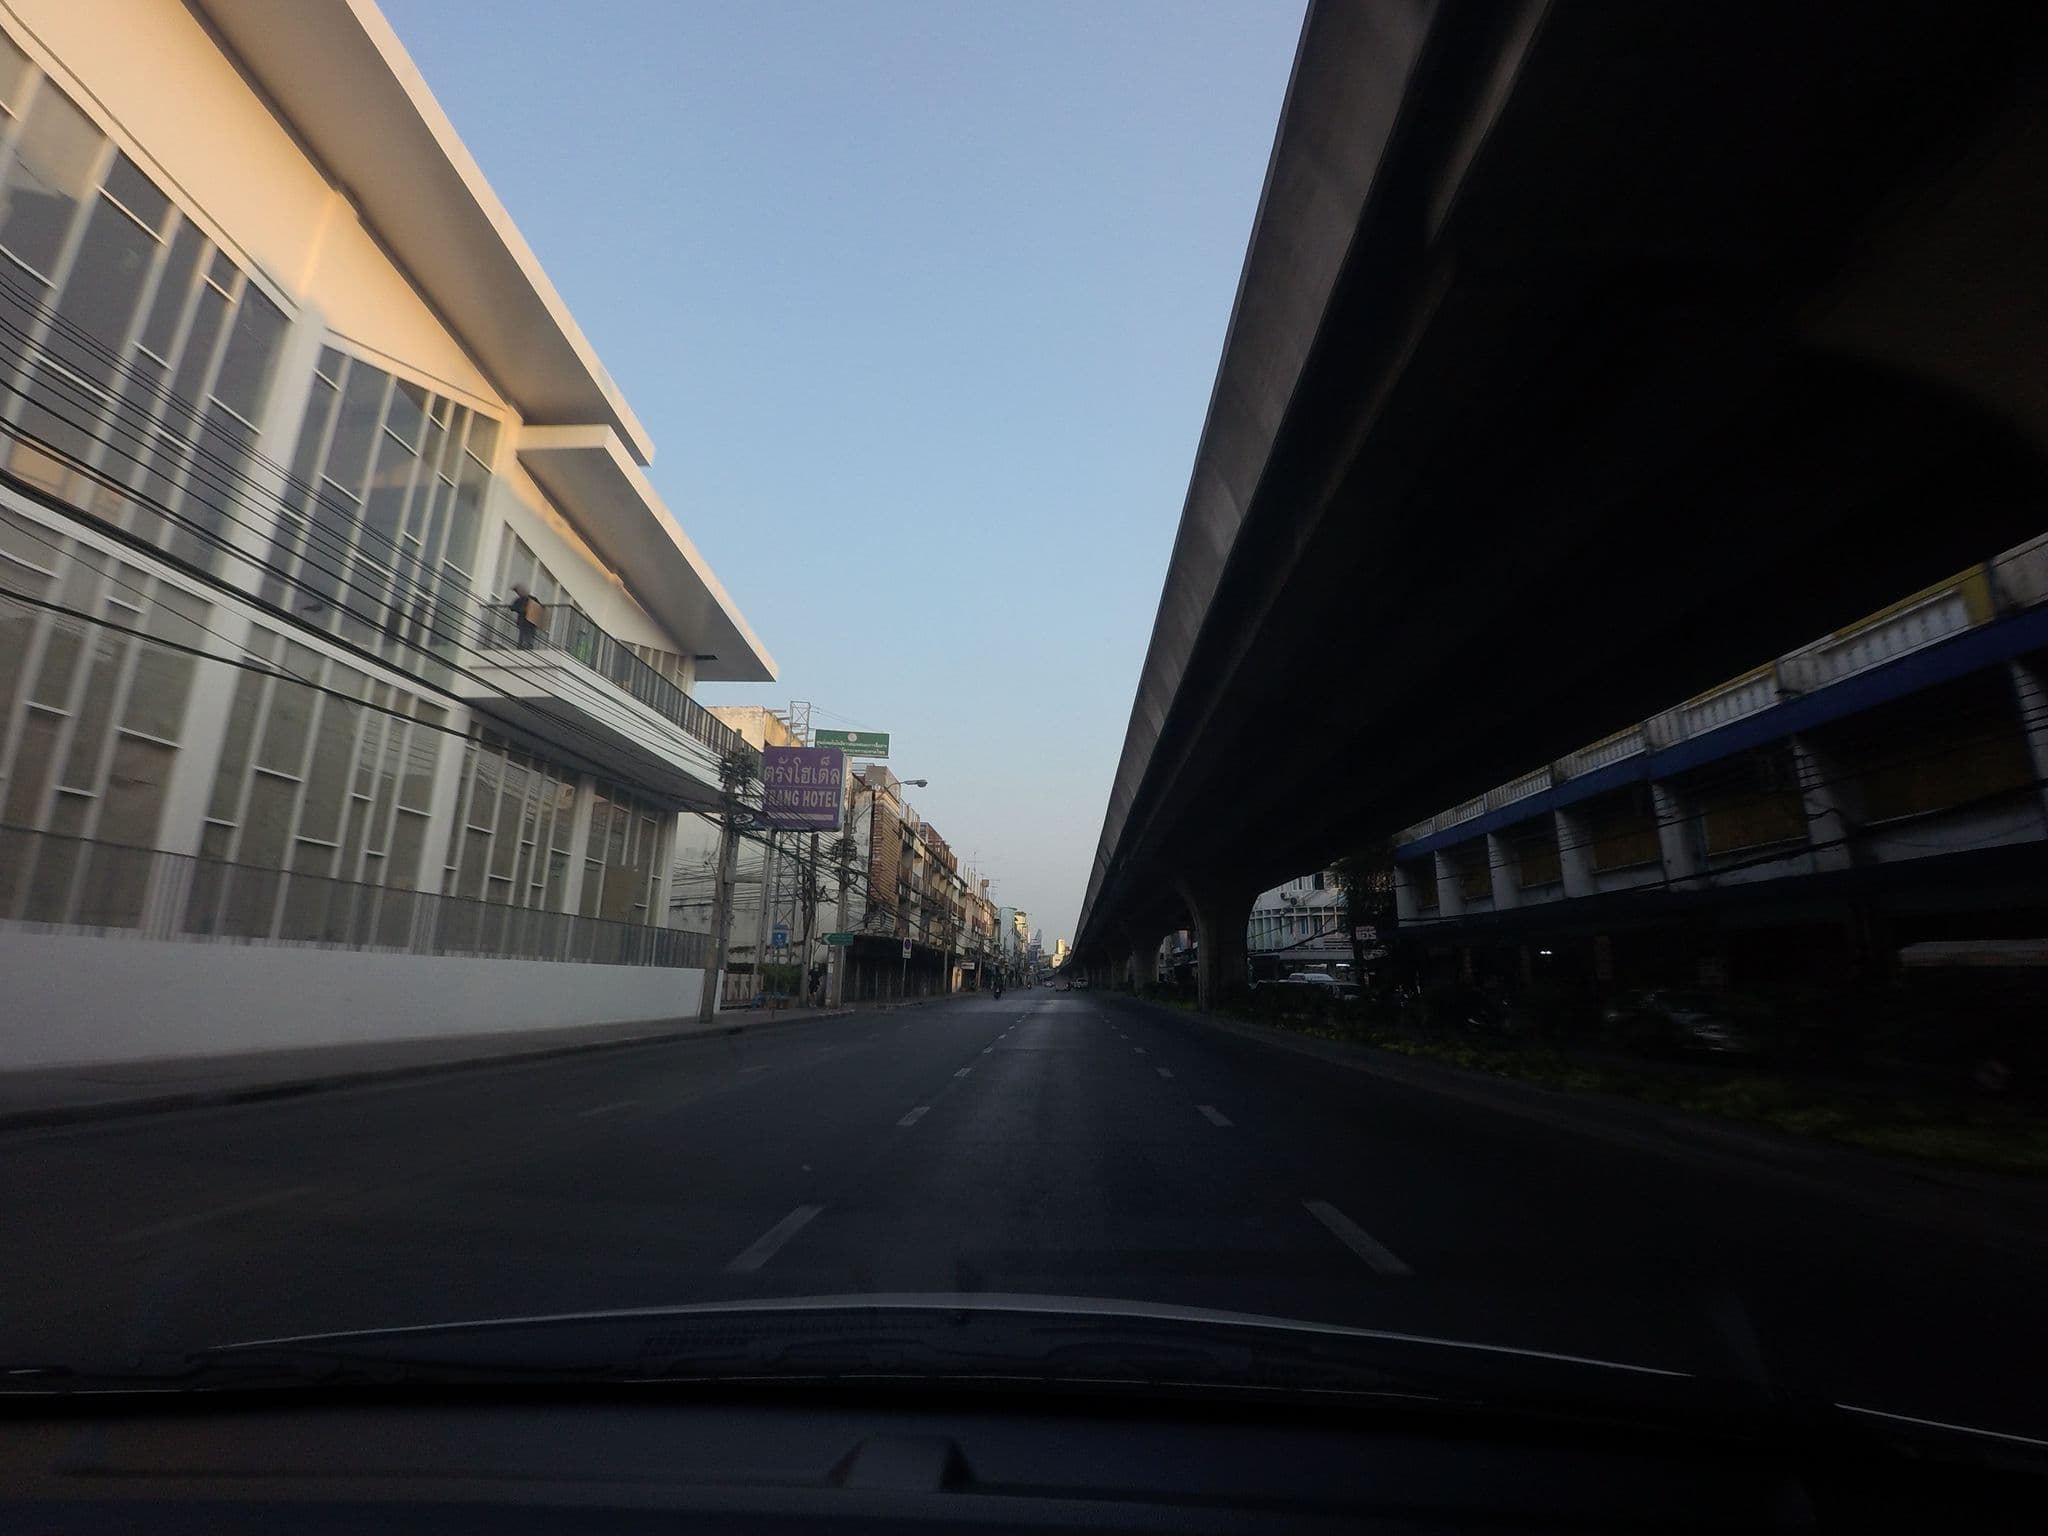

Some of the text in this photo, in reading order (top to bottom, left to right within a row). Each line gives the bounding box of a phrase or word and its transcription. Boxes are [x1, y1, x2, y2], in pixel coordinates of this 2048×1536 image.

[764, 756, 840, 785] ตรังโฮเต็ล
[802, 790, 838, 808] HOTEL
